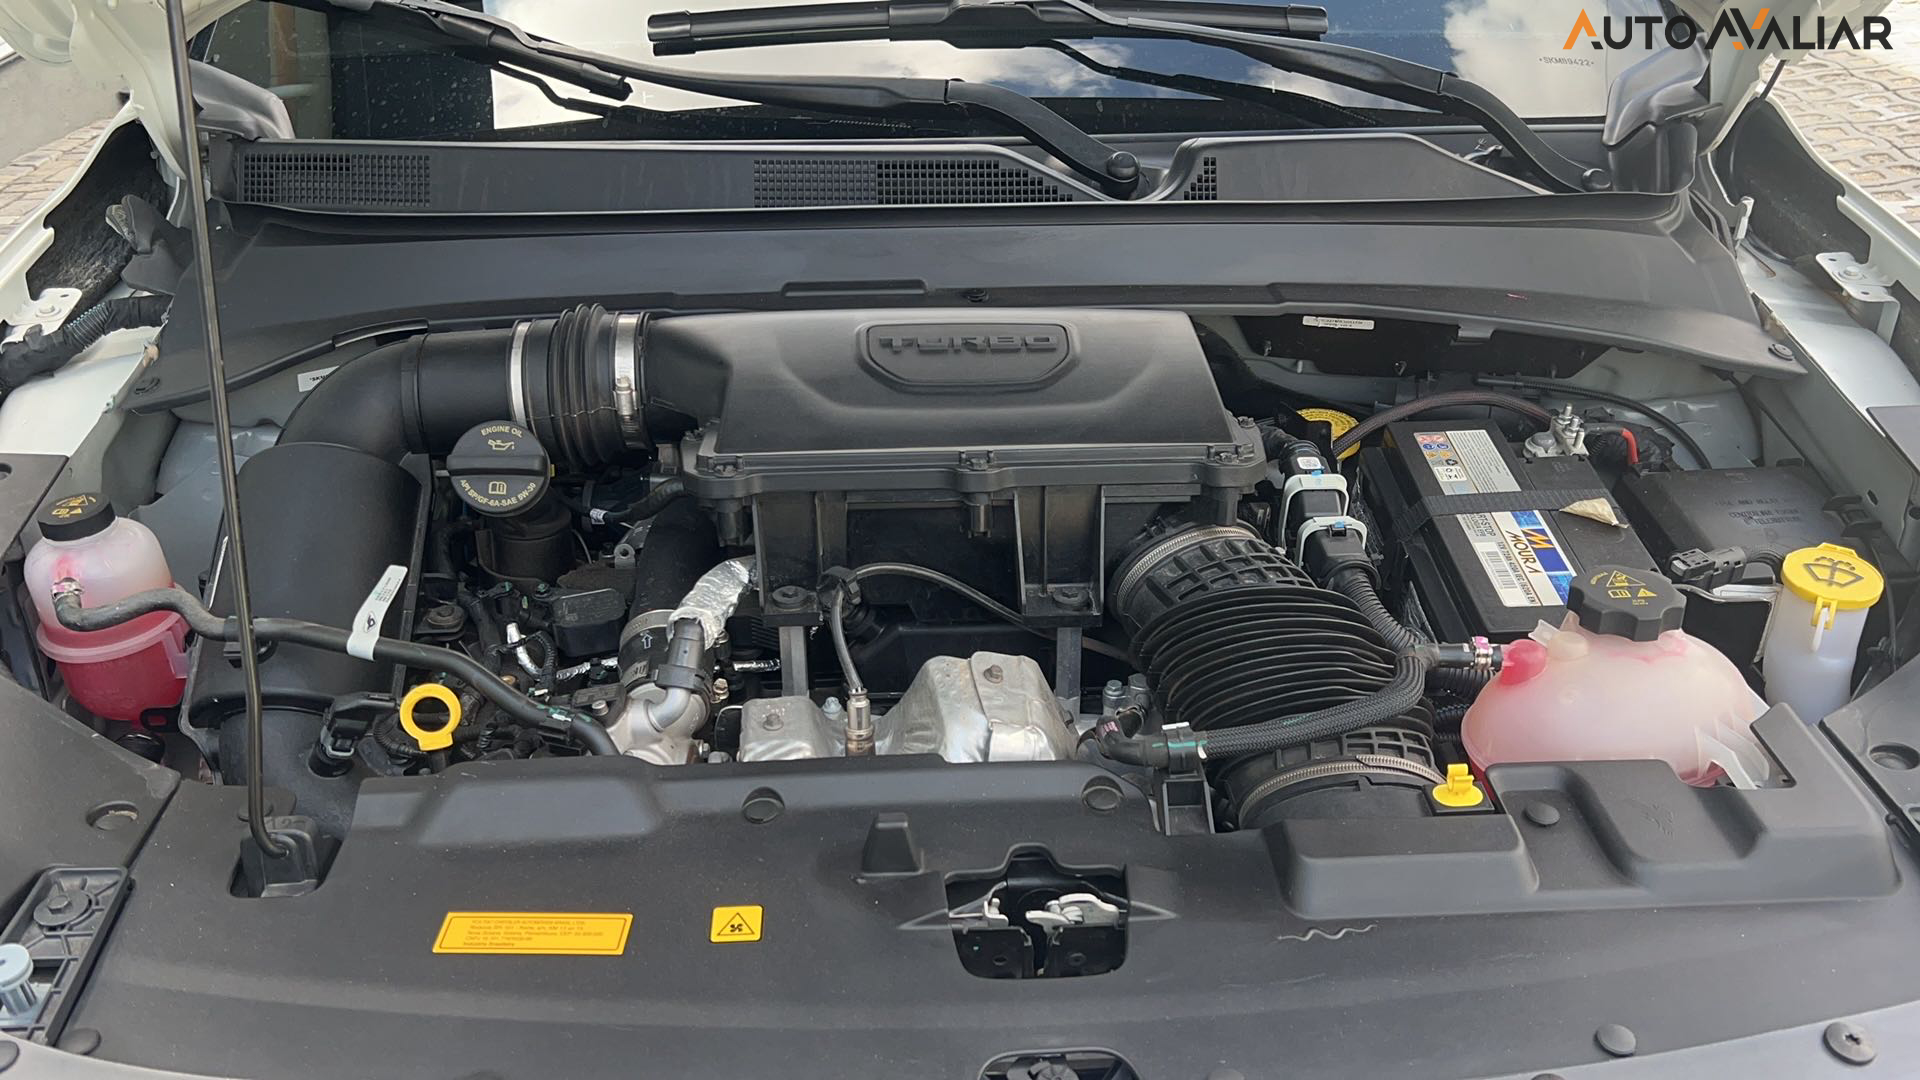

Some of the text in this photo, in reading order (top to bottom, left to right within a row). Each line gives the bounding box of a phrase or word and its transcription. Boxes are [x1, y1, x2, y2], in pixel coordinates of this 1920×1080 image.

[879, 336, 1058, 353] TURBO
[481, 425, 523, 438] ENGINE OIL
[460, 479, 471, 491] API
[517, 482, 537, 500] 5W-30
[1477, 512, 1497, 537] RT-STOP
[1505, 530, 1544, 574] MOURA
